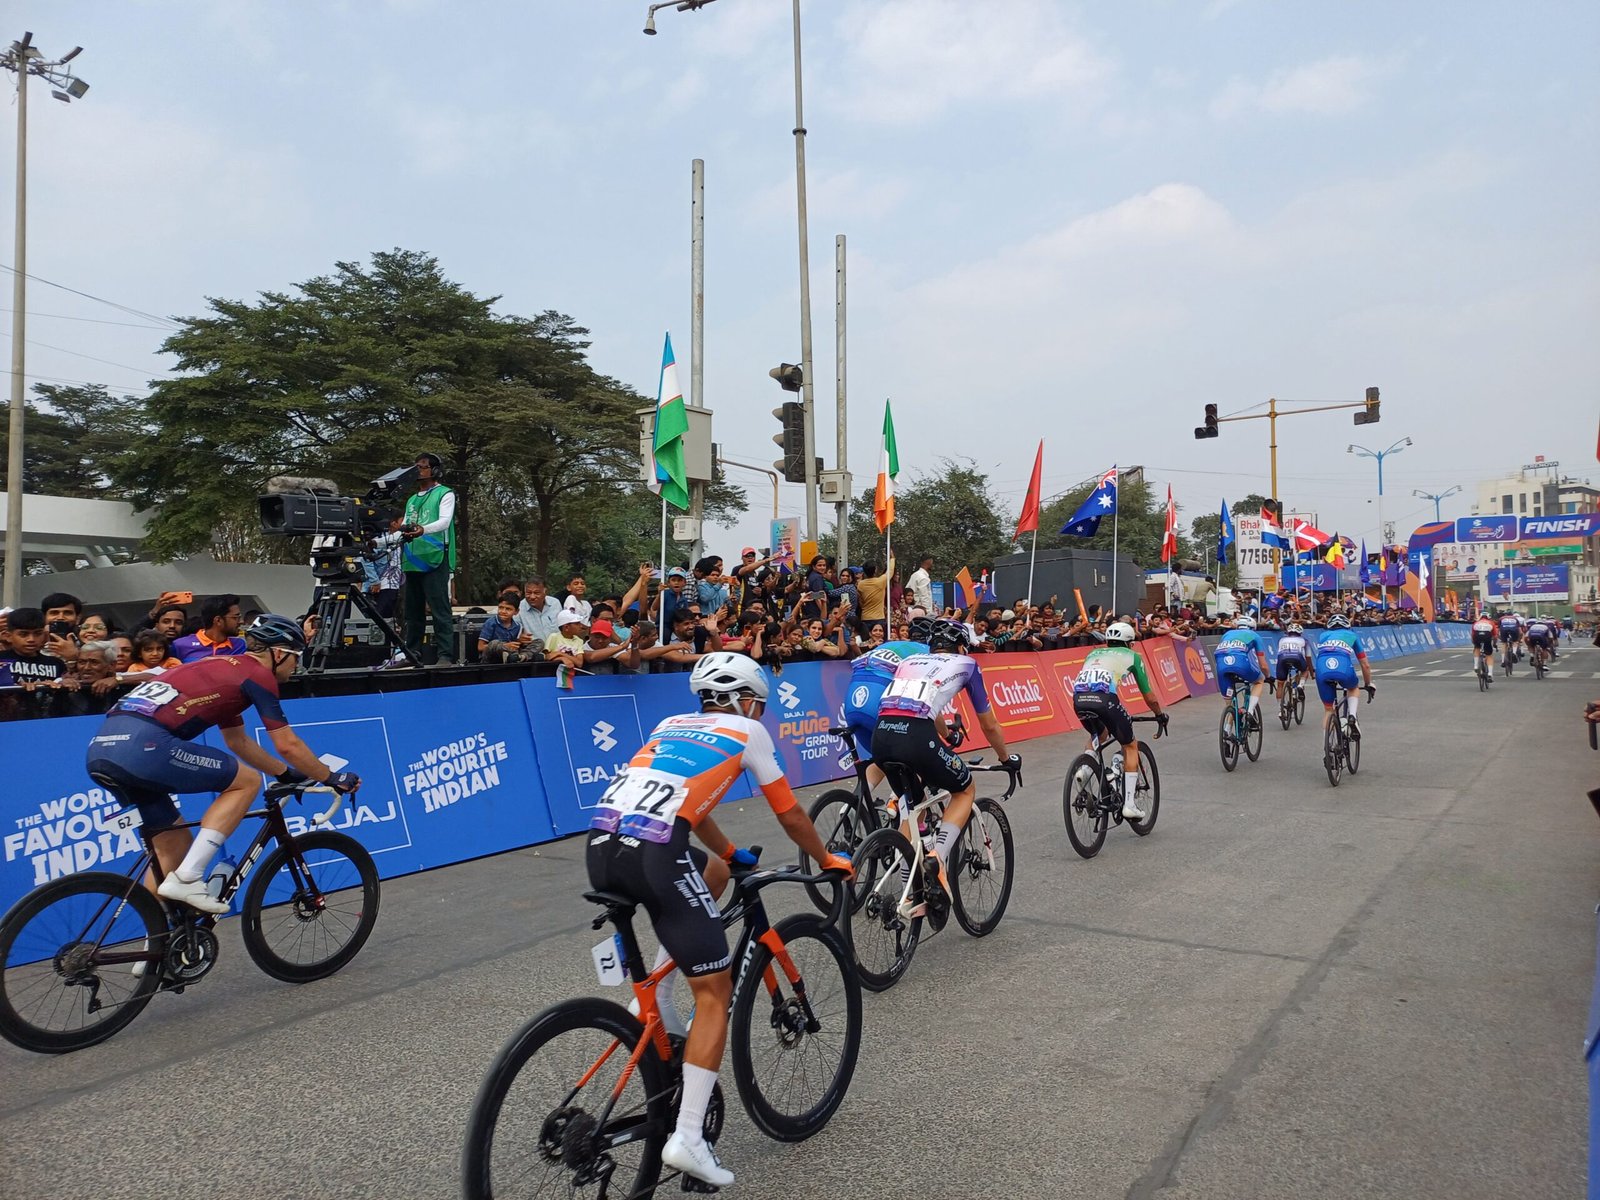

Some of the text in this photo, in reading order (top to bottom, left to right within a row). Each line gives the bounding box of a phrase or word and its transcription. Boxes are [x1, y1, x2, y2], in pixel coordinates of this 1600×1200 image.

[1525, 519, 1590, 534] FINISH
[918, 681, 927, 699] 1
[784, 710, 805, 719] BAJAJ
[805, 734, 840, 748] GRAND
[408, 732, 488, 772] THE WORLD'S
[801, 746, 829, 761] TOUR
[403, 741, 508, 796] FAVOURITE
[421, 764, 501, 814] INDIAN
[634, 779, 676, 817] 22
[15, 813, 43, 829] THE
[118, 816, 132, 830] 62
[31, 828, 148, 887] INDIA
[600, 952, 615, 974] 22
